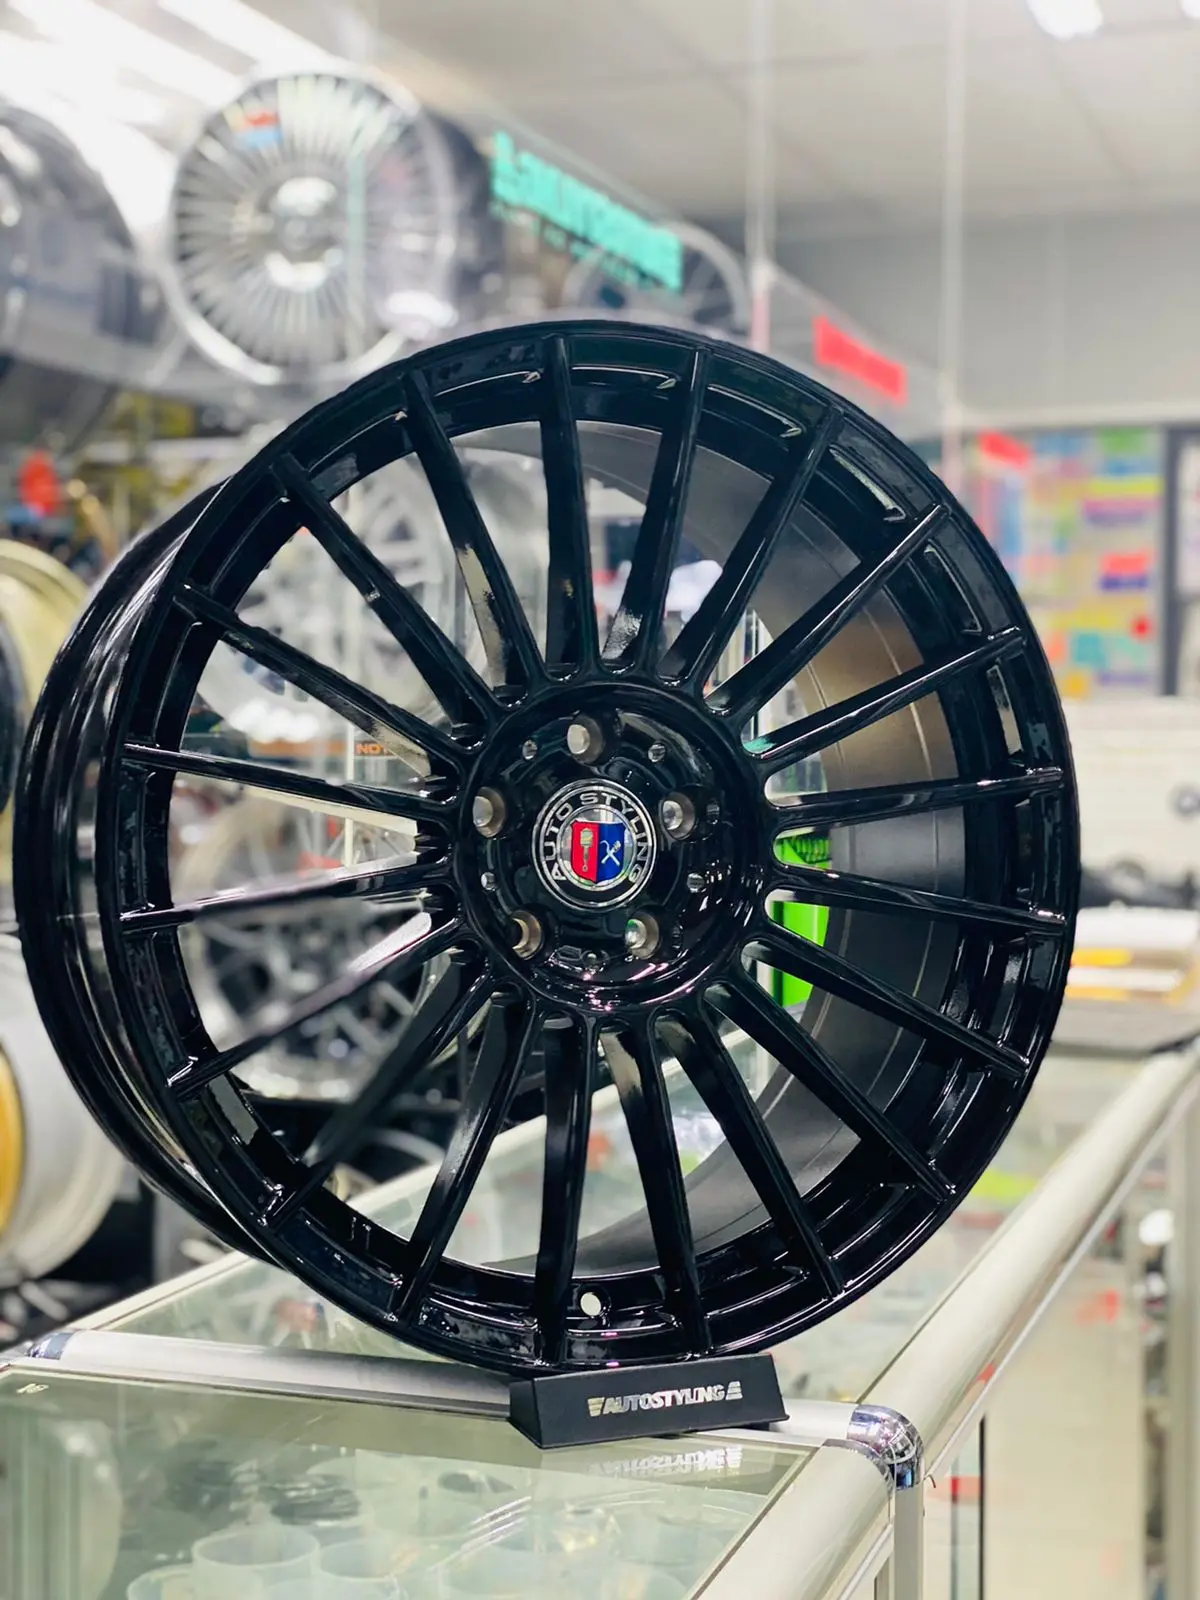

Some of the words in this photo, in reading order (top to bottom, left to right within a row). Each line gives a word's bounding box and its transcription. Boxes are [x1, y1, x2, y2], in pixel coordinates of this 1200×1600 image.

[544, 803, 574, 882] AUTO
[579, 793, 650, 883] STYLING
[603, 1385, 725, 1414] AUTOSTYLING
